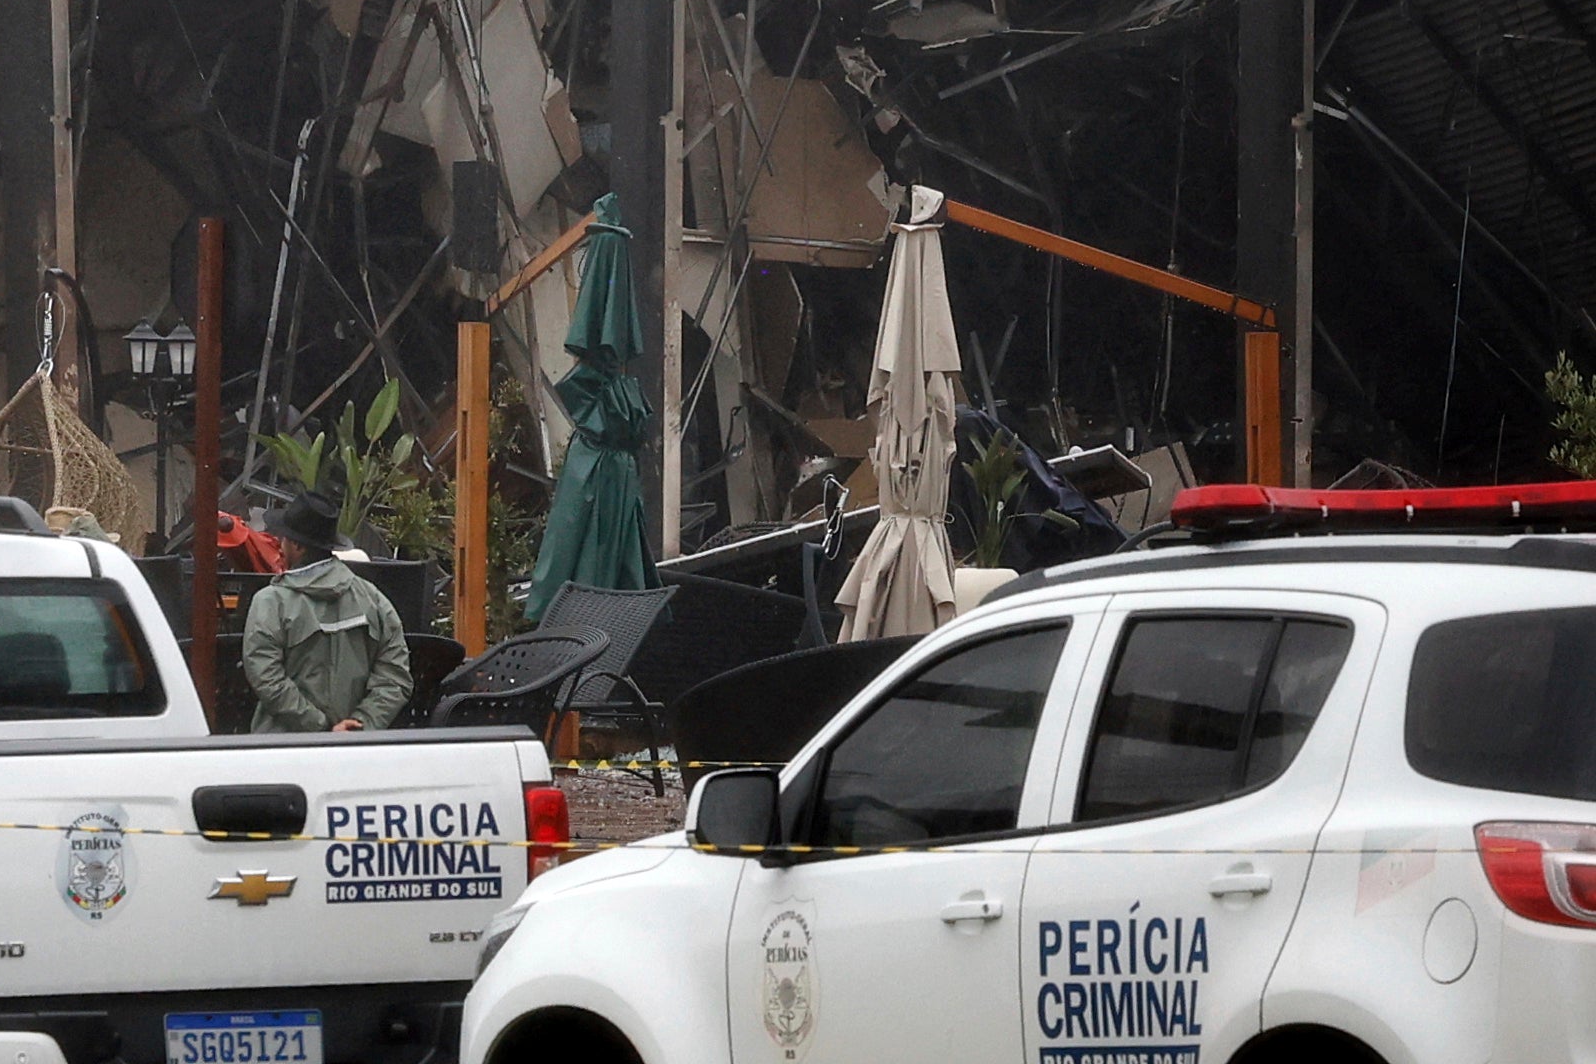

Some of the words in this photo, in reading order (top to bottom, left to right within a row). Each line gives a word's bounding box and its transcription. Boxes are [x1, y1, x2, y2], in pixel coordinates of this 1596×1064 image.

[71, 836, 122, 850] PERÍCIAS
[325, 841, 502, 878] CRIMINAL
[328, 886, 357, 900] RIO
[363, 883, 433, 899] GRANDE
[438, 883, 461, 896] DO
[466, 882, 499, 896] SUL
[1039, 900, 1209, 977] PERÍCIA
[1037, 980, 1202, 1039] CRIMINAL
[183, 1030, 307, 1063] SGQ5I21
